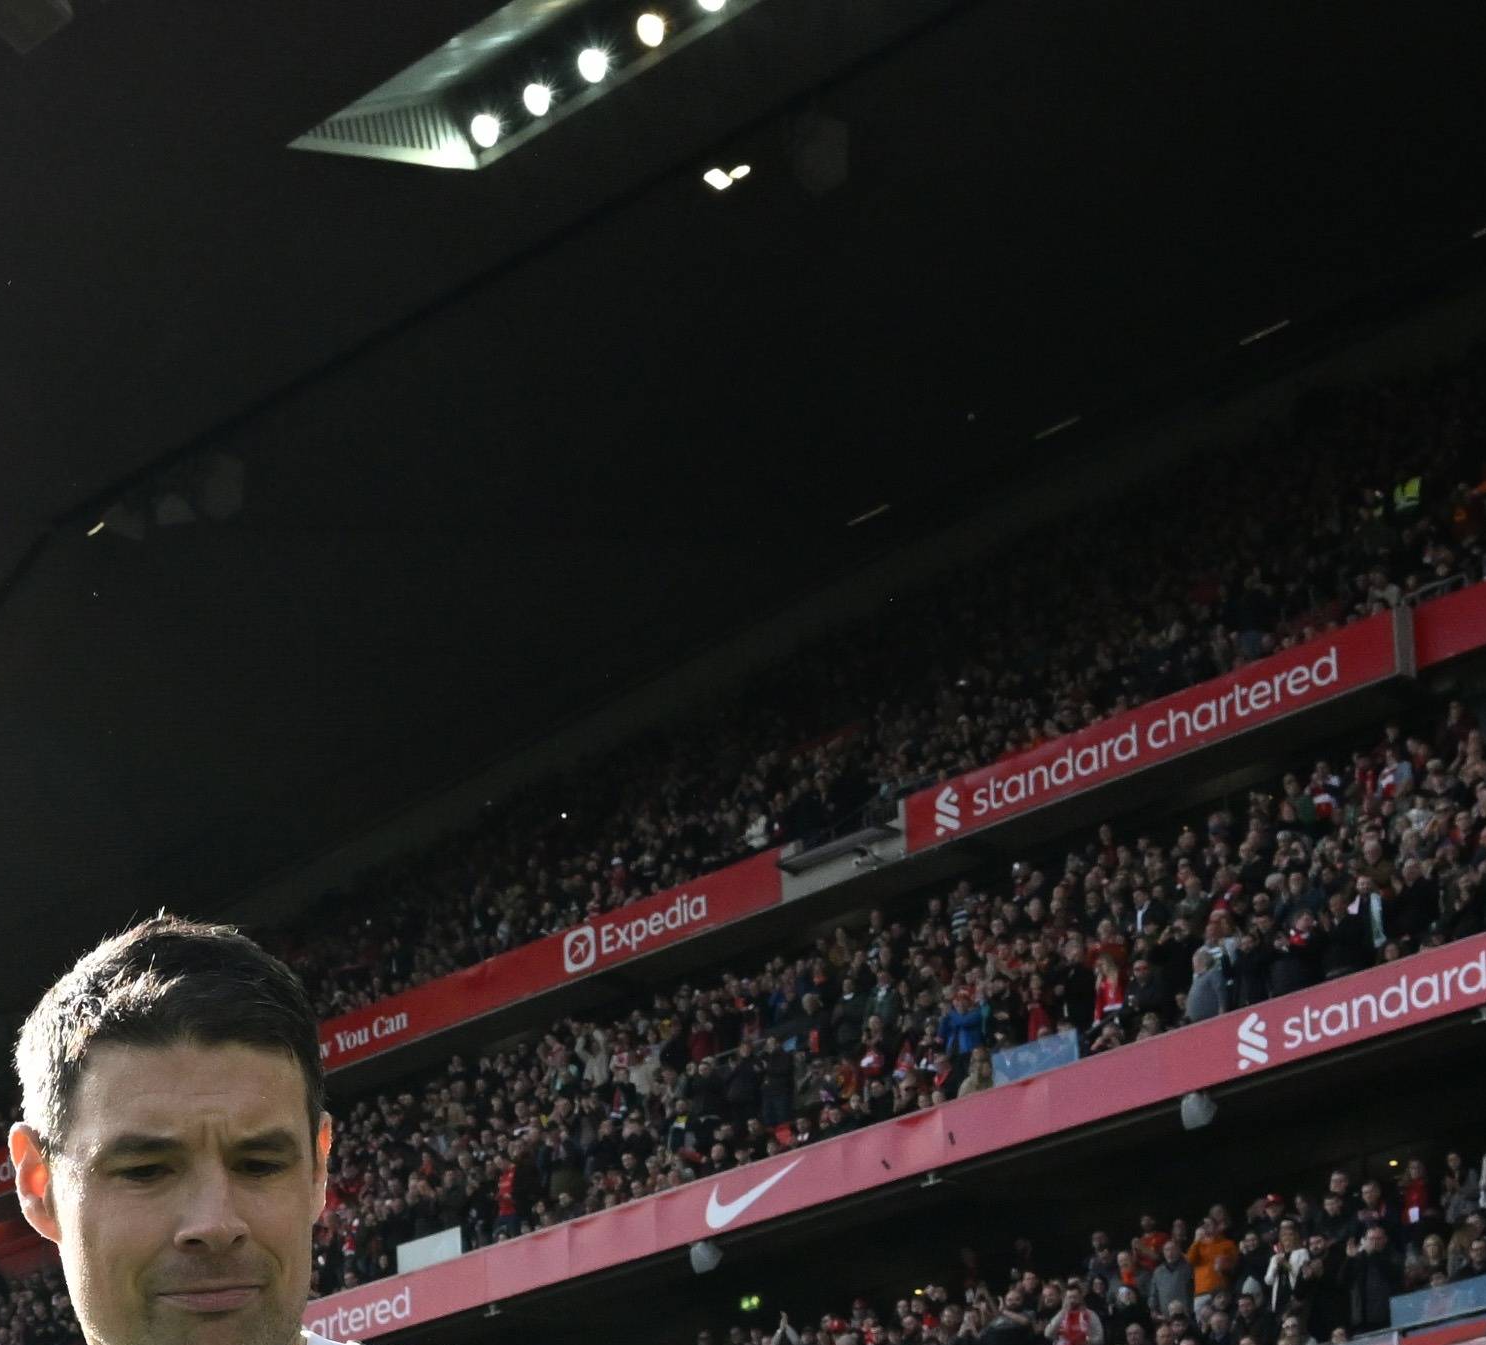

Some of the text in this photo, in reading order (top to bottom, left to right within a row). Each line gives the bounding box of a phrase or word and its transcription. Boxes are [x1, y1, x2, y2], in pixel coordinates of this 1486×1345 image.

[972, 647, 1339, 817] standard chartered
[600, 895, 707, 954] Expedia
[334, 1027, 369, 1054] You
[371, 1012, 409, 1038] Can
[305, 1287, 412, 1339] artered
